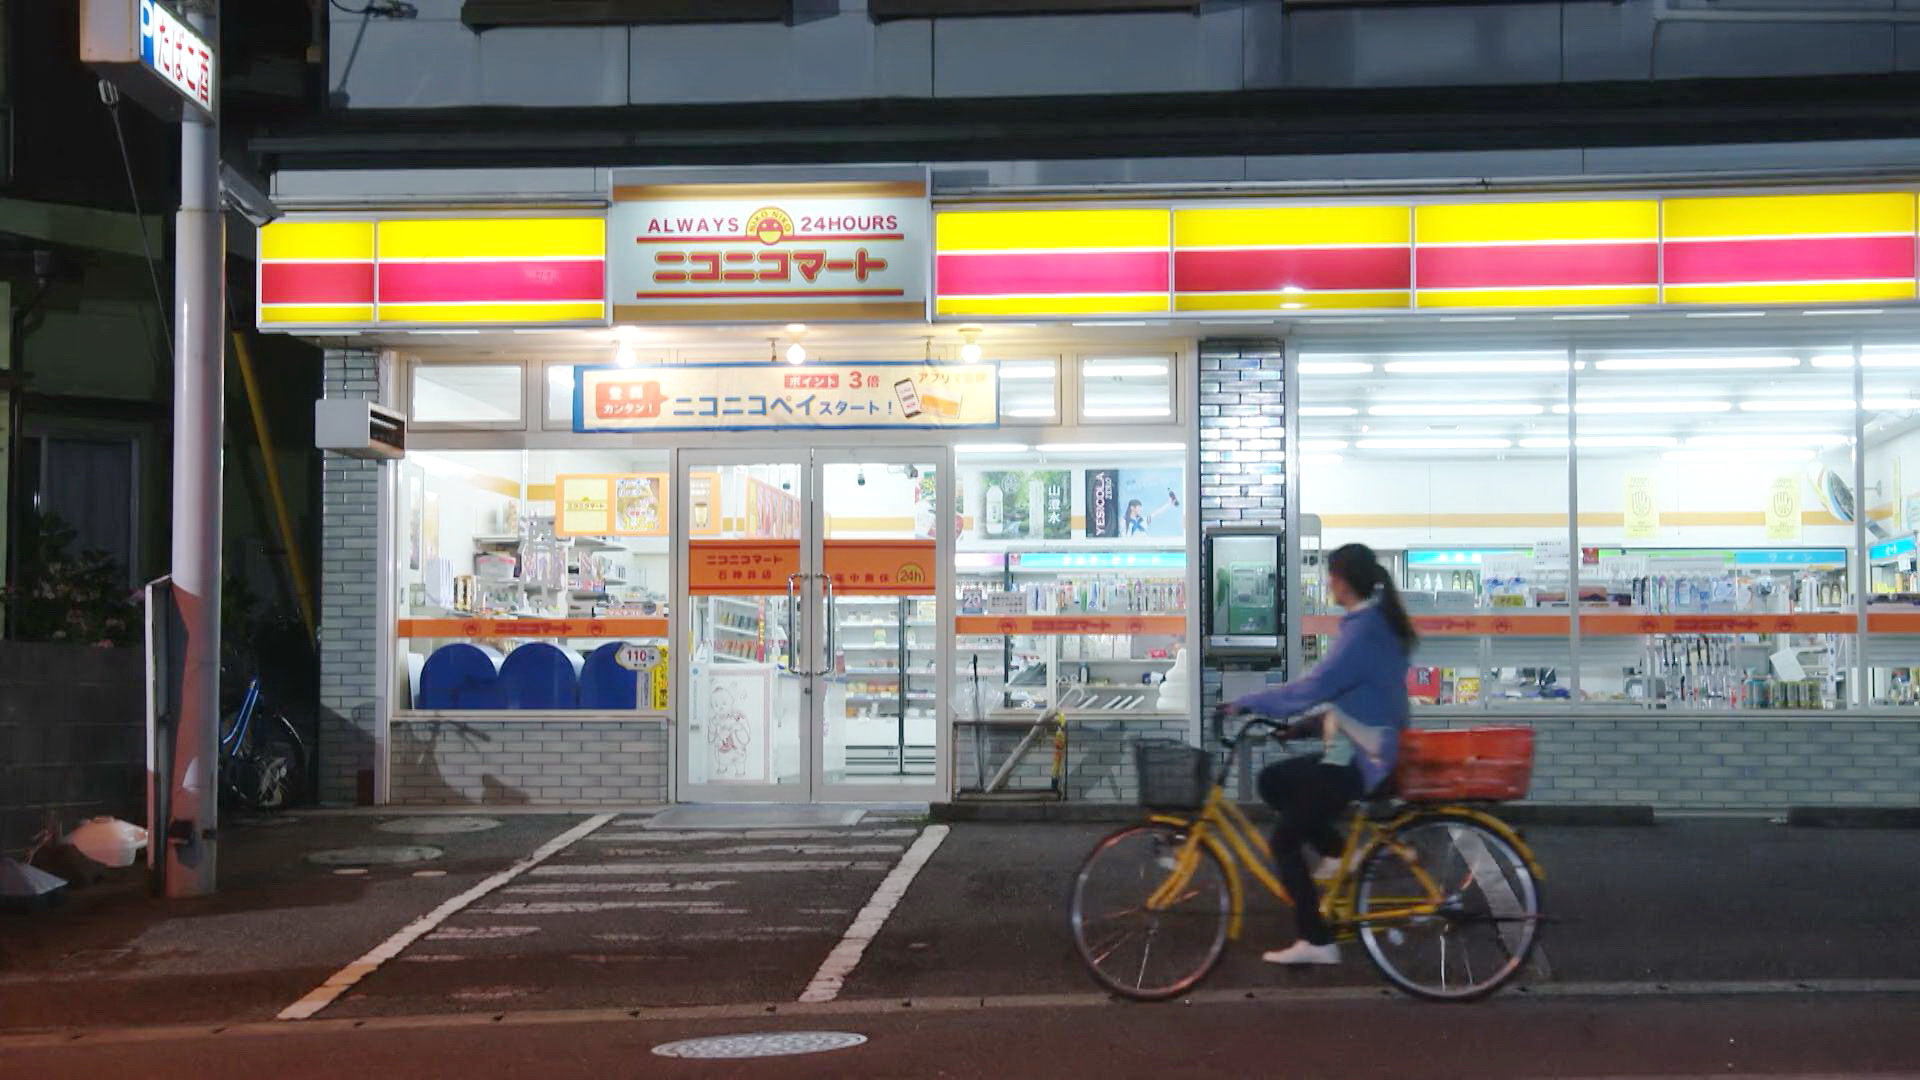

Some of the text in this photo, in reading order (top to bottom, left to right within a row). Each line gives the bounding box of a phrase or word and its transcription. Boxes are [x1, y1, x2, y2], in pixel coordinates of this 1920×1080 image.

[647, 215, 898, 233] ALWAYS 24HOURS
[653, 247, 887, 282] ニコニコマート
[788, 375, 838, 388] ポイント
[706, 553, 783, 565] ニコニコマート
[900, 569, 922, 583] 24h
